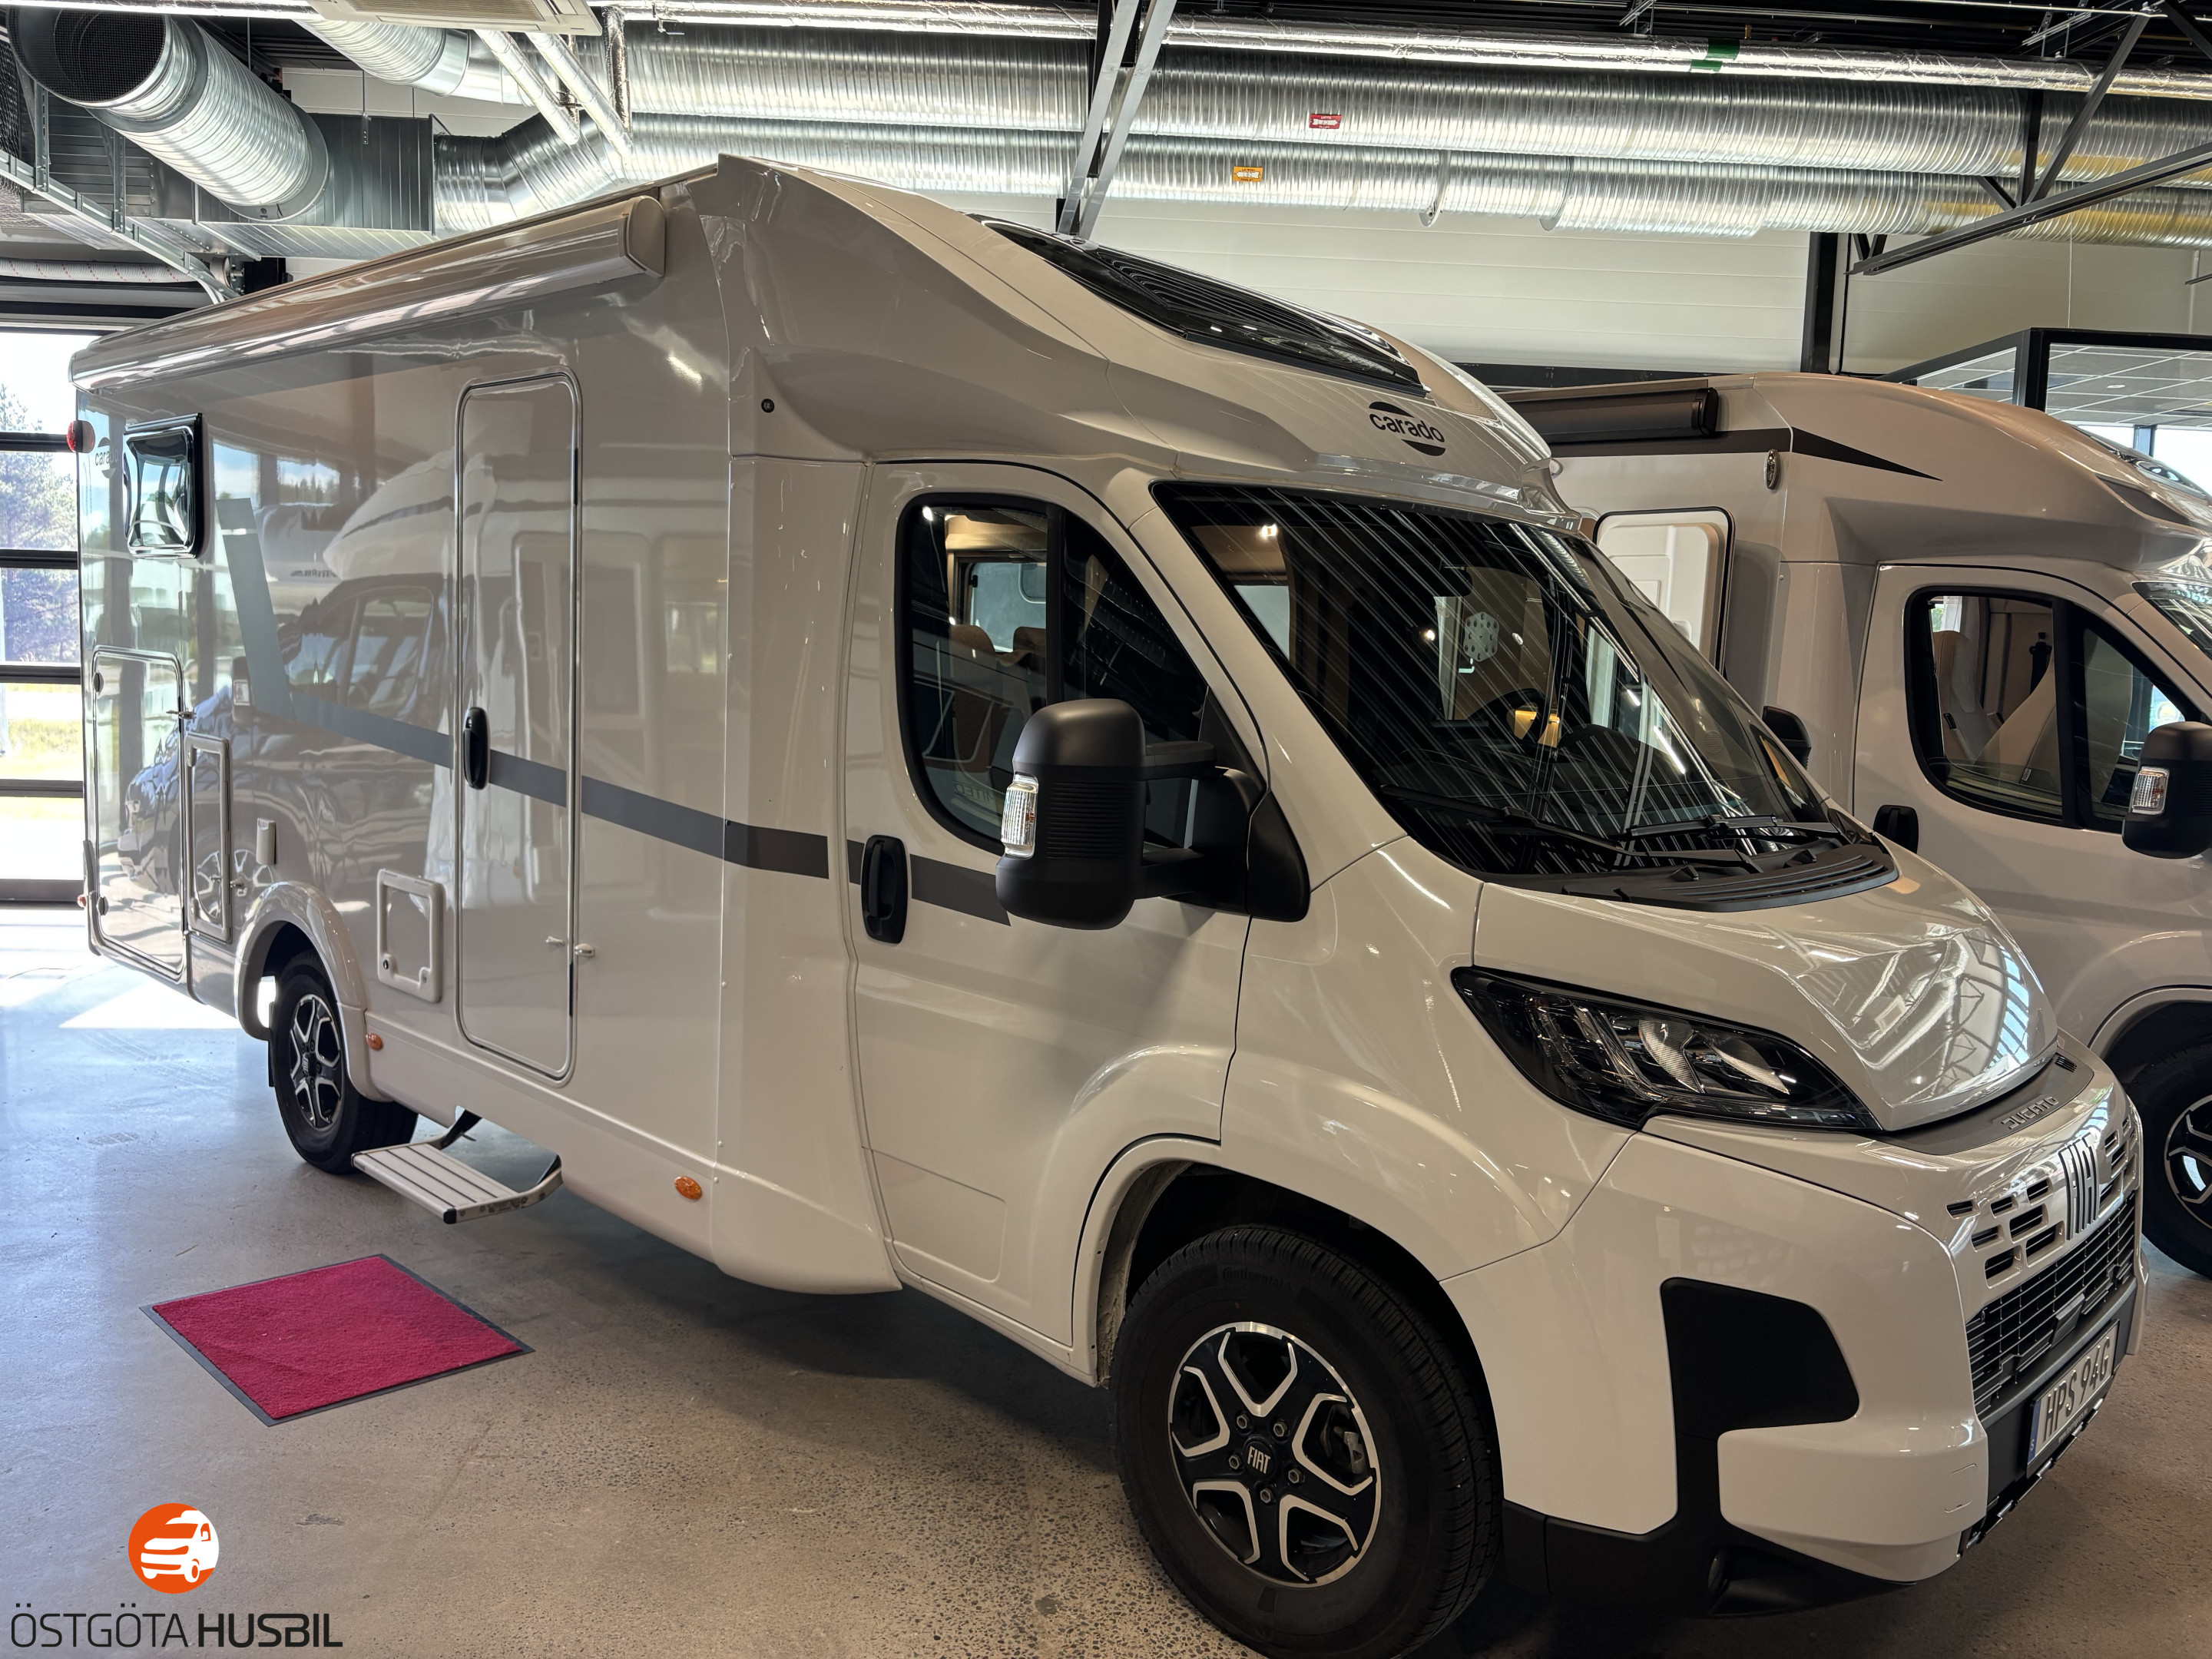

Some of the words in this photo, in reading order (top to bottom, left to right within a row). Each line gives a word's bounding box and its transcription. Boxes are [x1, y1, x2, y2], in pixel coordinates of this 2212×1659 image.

[1369, 413, 1445, 443] carado
[94, 449, 118, 466] carado
[2000, 1096, 2059, 1130] DUCATO
[2058, 1131, 2099, 1240] FIAT
[2043, 1369, 2078, 1443] HPS
[2078, 1336, 2111, 1406] 94G
[1247, 1445, 1271, 1474] FIAT
